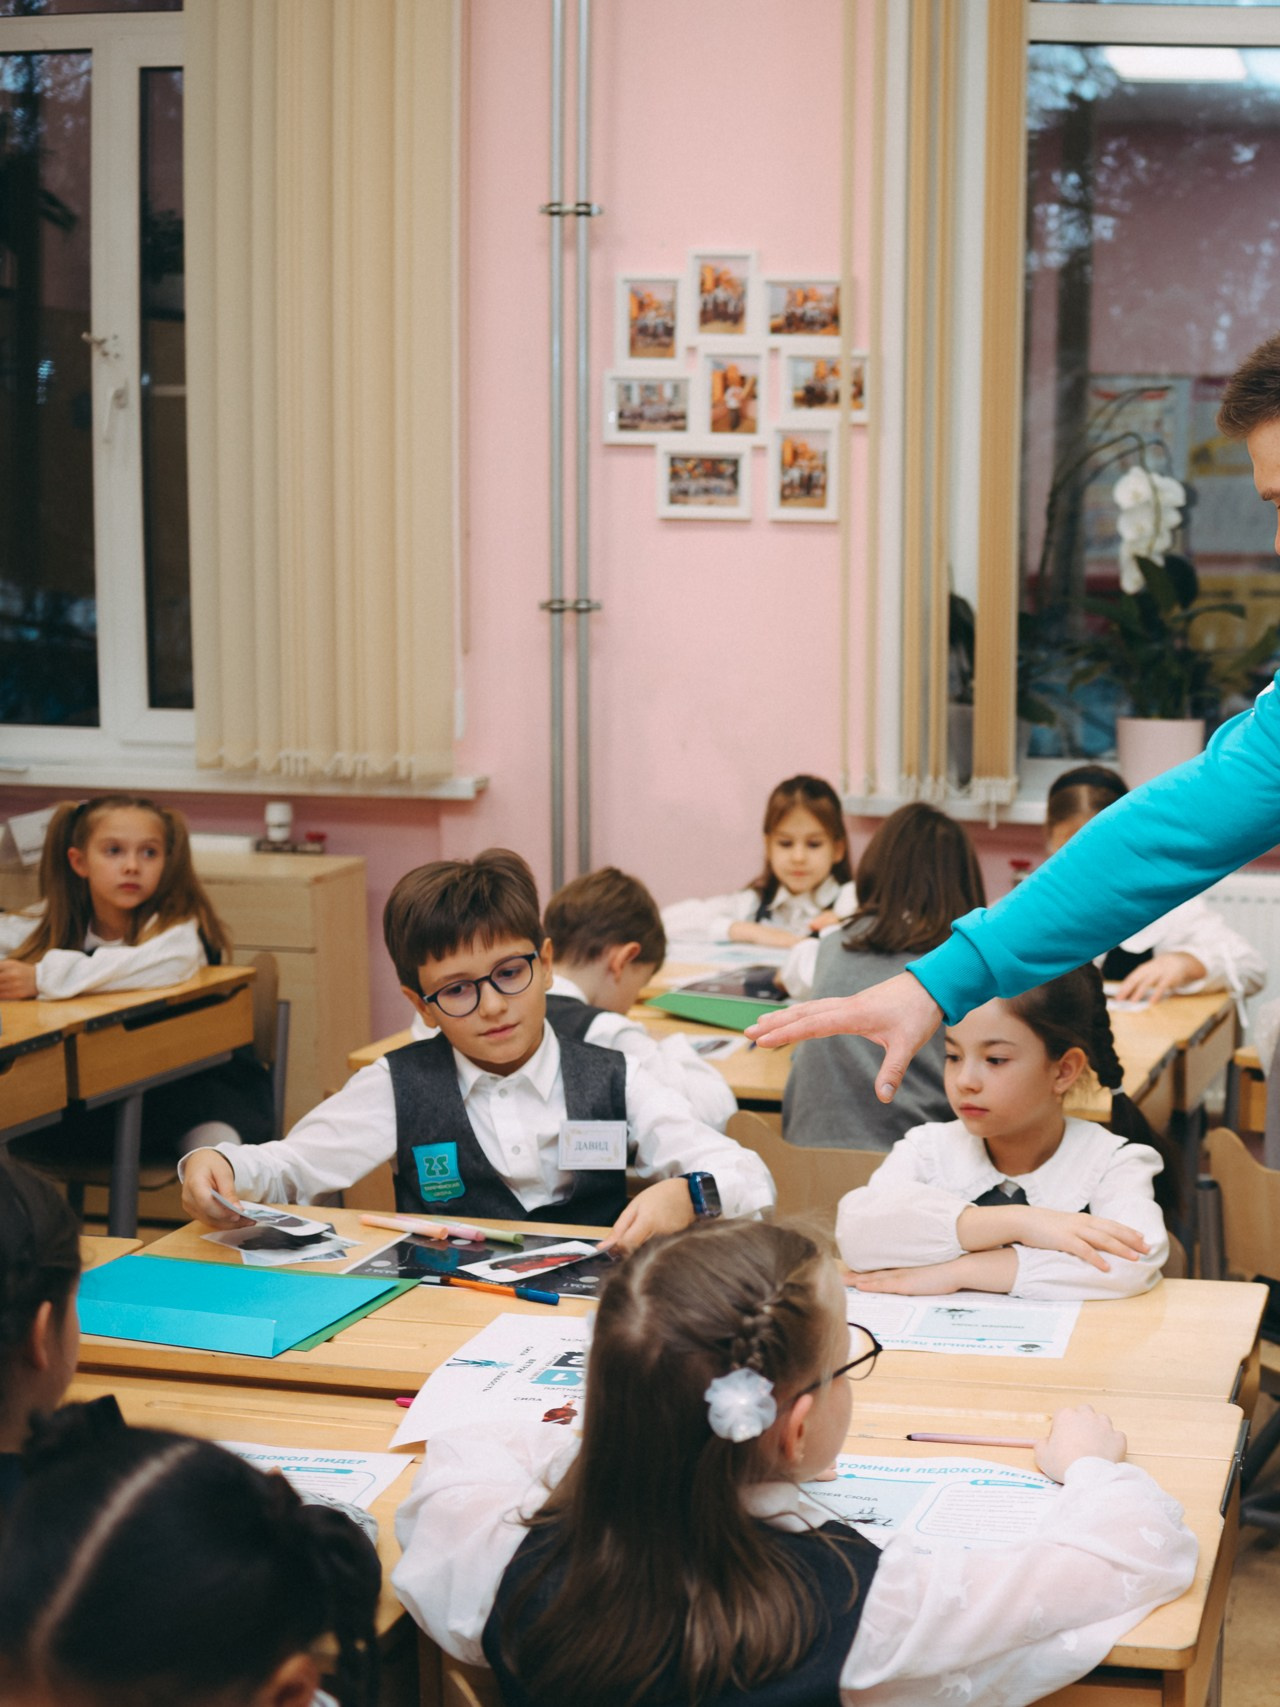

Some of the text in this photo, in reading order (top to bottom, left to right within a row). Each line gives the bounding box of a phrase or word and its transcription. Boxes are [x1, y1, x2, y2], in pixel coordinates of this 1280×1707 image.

[574, 1140, 609, 1151] ДАВИД
[237, 1452, 367, 1465] ЛЕДОКОЛ ЛИДЕР
[837, 1462, 911, 1474] ТОМНЫЙ
[915, 1466, 994, 1475] ЛЕДОКОЛ
